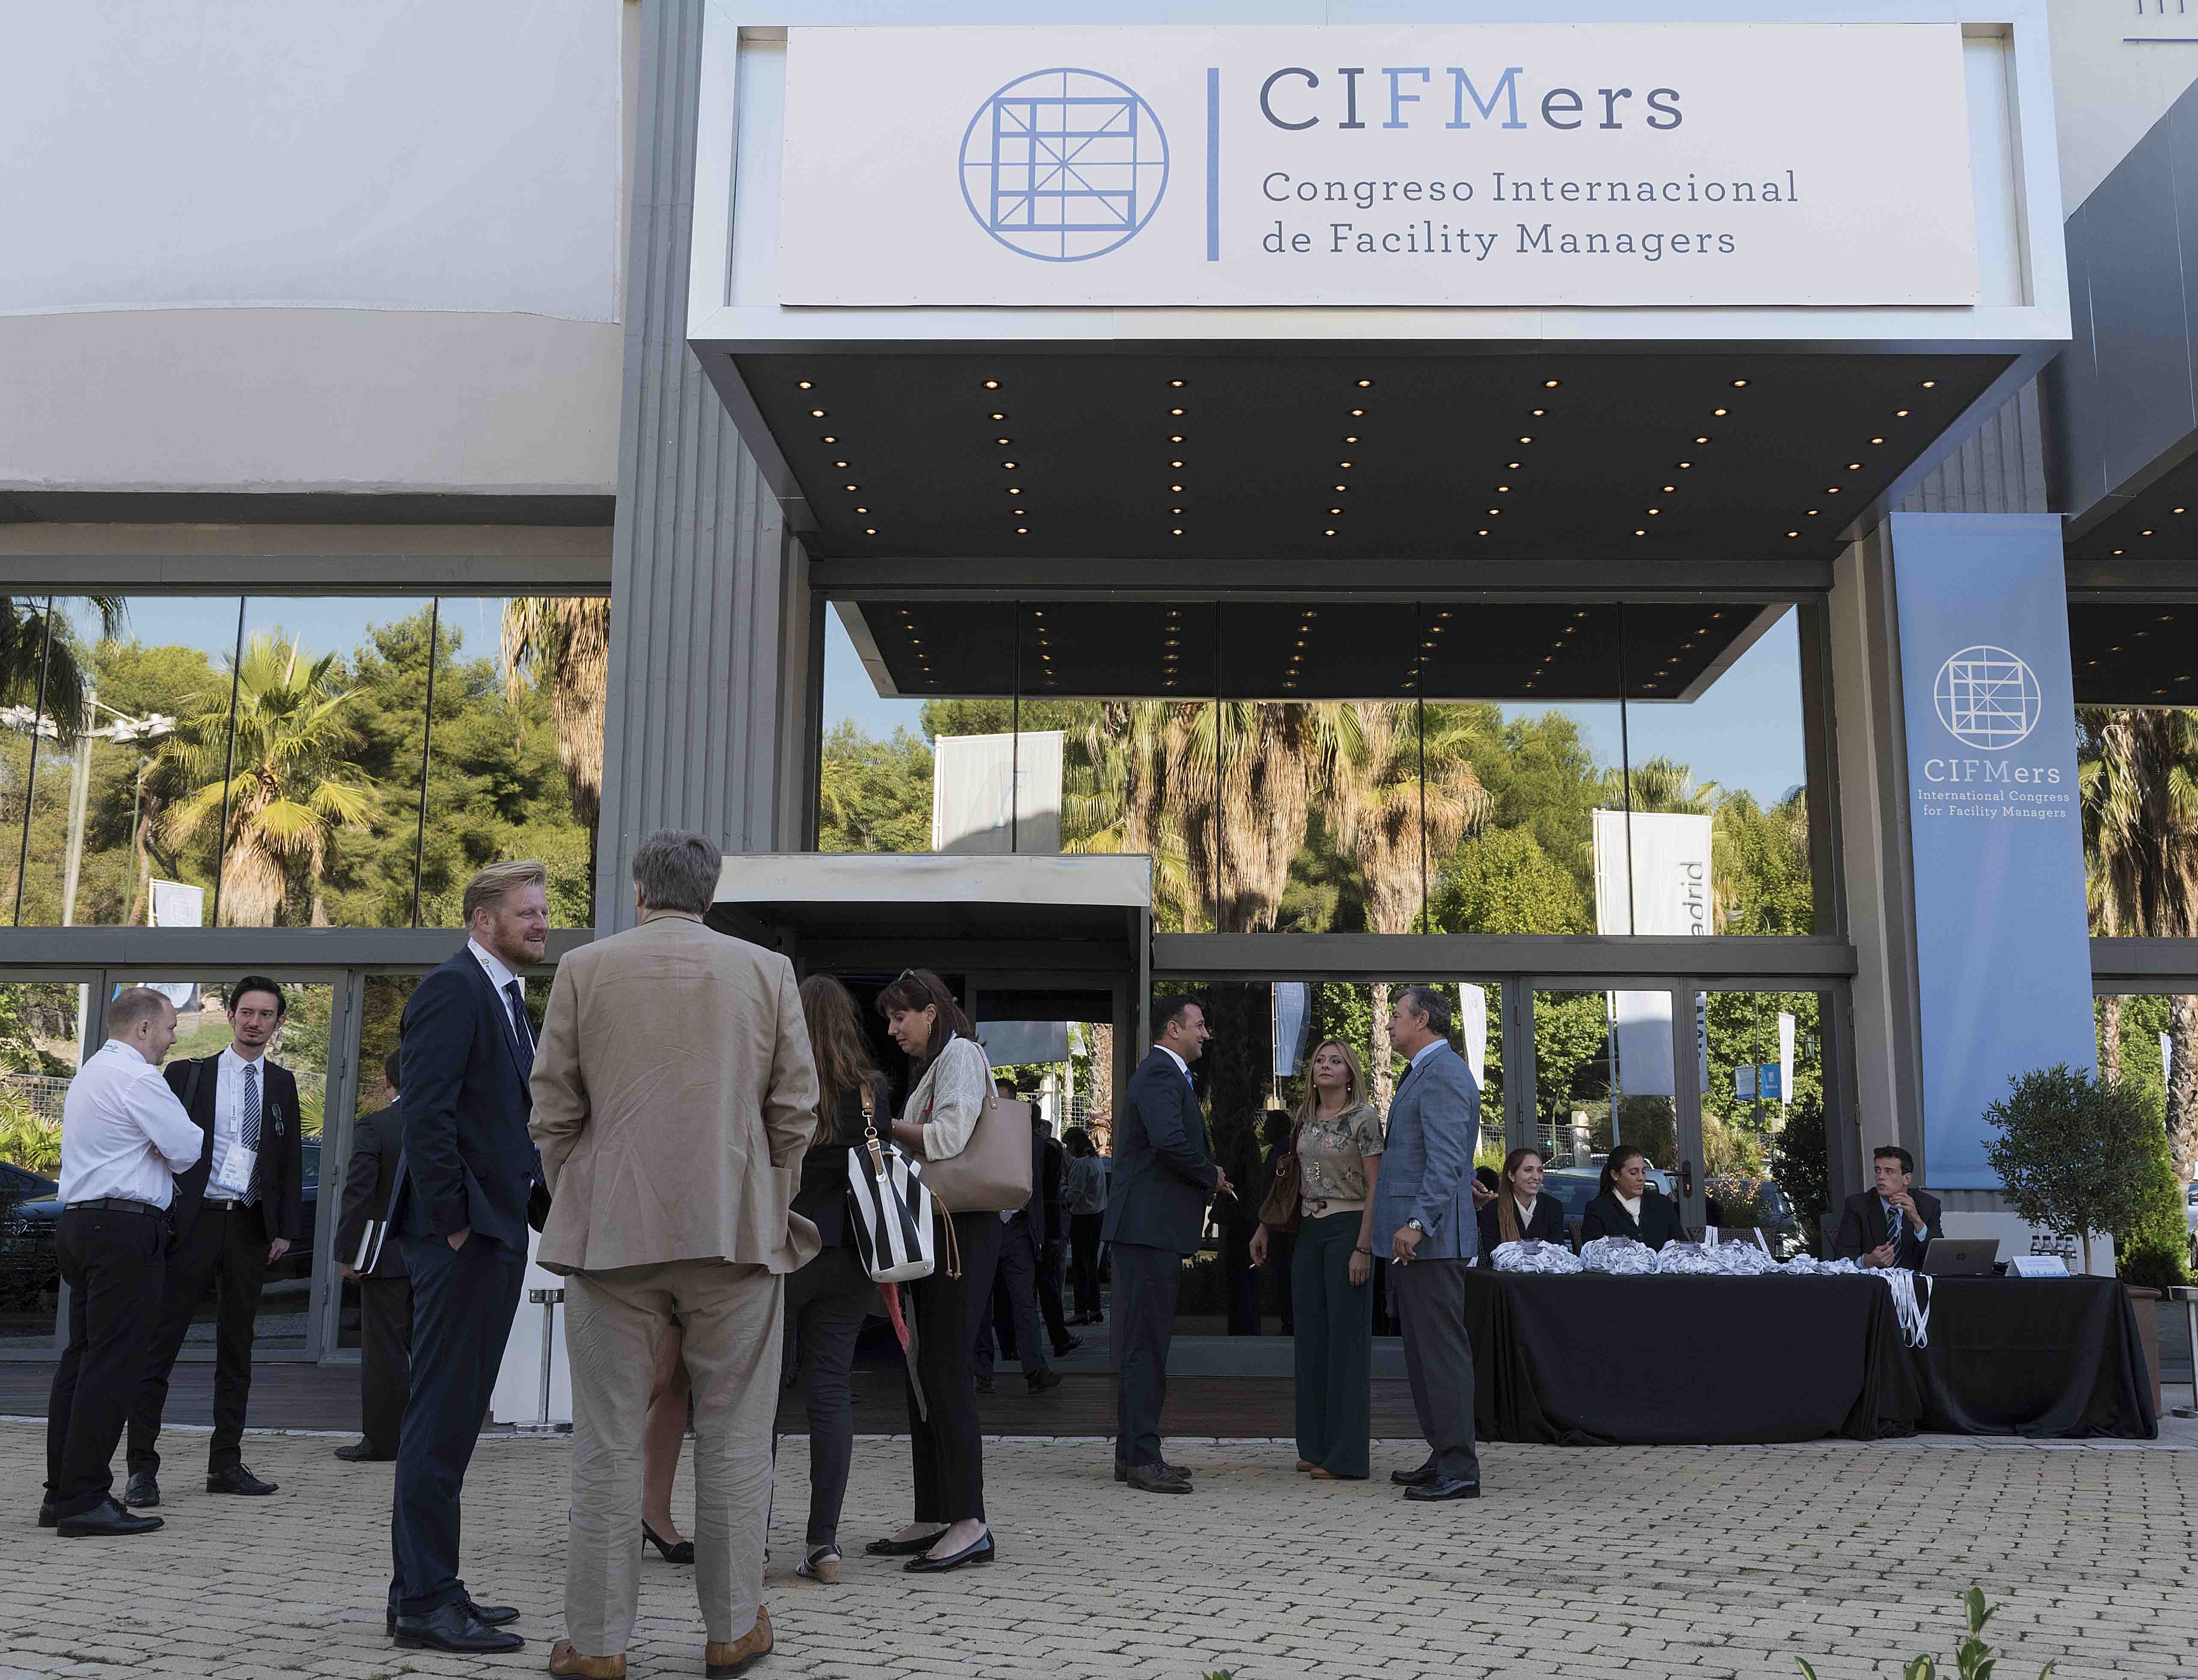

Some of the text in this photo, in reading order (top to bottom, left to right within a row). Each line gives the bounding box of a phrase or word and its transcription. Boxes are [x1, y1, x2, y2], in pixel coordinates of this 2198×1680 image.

[1260, 67, 1683, 131] CIFMers
[1263, 170, 1799, 209] Congreso Internacional
[1263, 220, 1735, 261] de Facility Managers
[1924, 759, 2061, 784] CIFMers
[1917, 790, 2070, 804] International Congress
[1923, 804, 2066, 819] for Facility Managers
